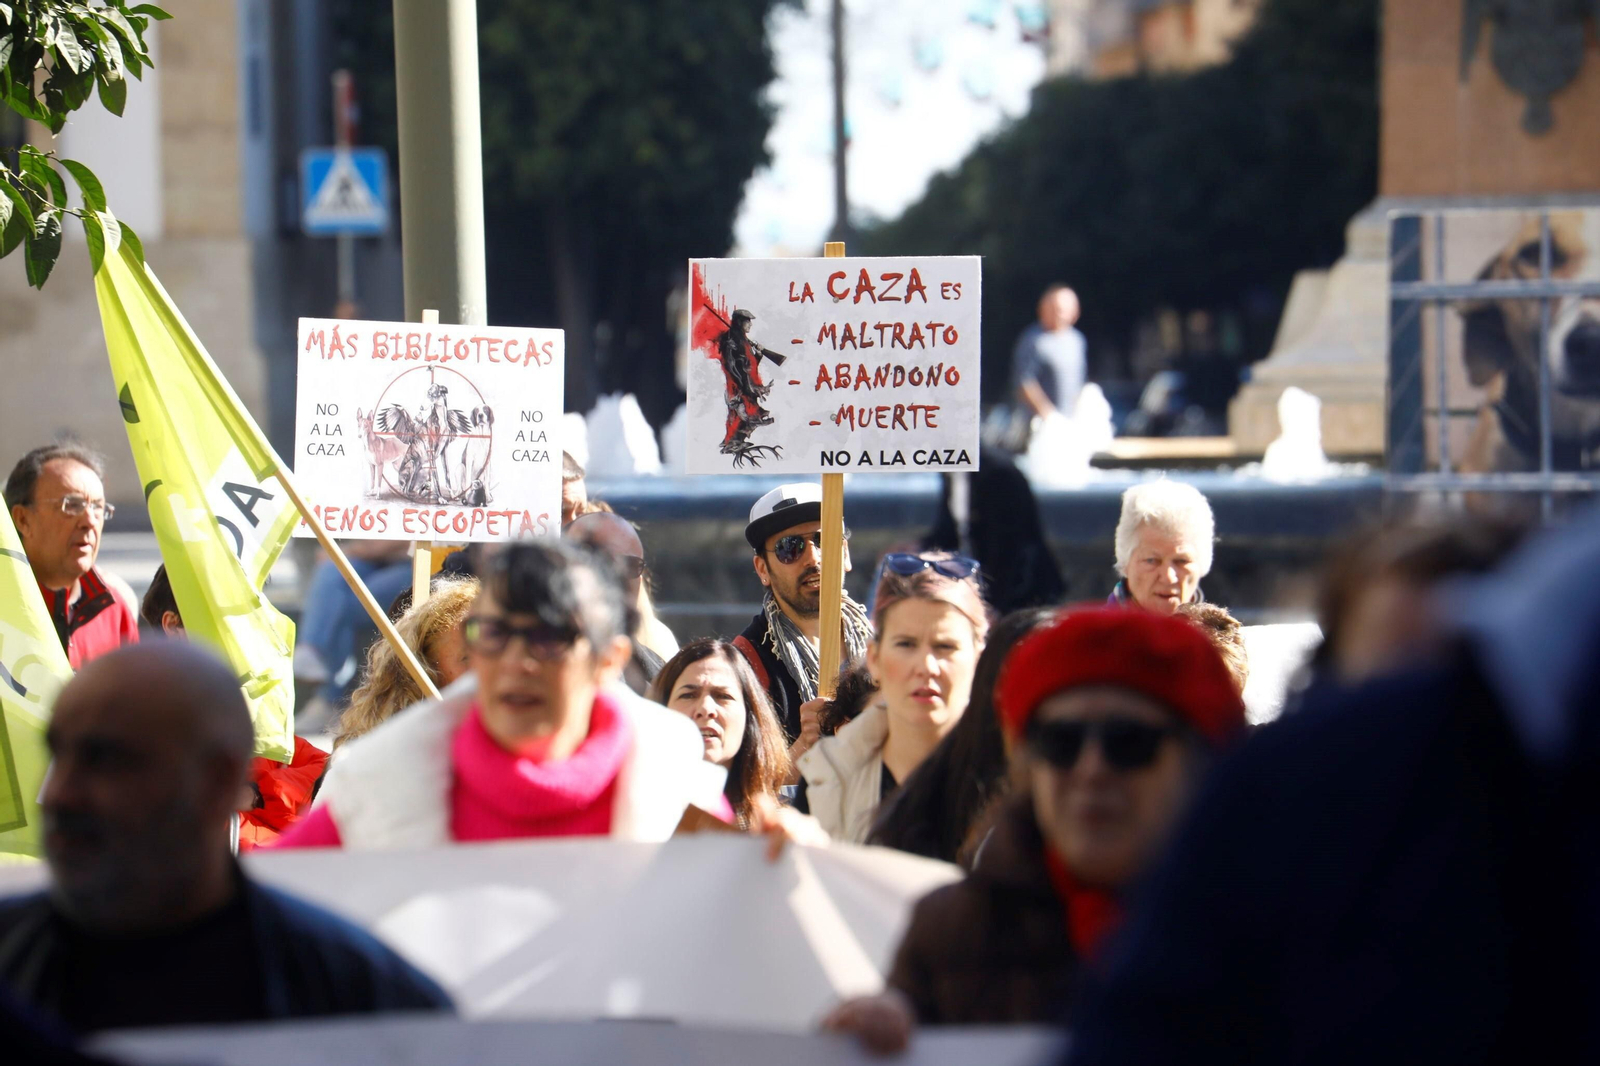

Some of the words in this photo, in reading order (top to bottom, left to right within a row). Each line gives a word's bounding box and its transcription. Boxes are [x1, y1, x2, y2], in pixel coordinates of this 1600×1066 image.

[788, 281, 814, 303] LA
[826, 268, 927, 304] CAZA
[940, 282, 962, 300] ES
[817, 321, 958, 350] MALTRATO
[305, 325, 358, 360] MÁS
[371, 331, 554, 367] BIBLIOTECAS
[814, 363, 960, 391] ABANDONO
[316, 403, 339, 416] NO
[520, 410, 543, 423] NO
[835, 403, 941, 431] MUERTE
[310, 424, 321, 436] A
[325, 424, 343, 436] LA
[515, 430, 526, 442] A
[530, 430, 548, 443] LA
[307, 443, 345, 456] CAZA
[512, 449, 550, 463] CAZA
[821, 450, 851, 466] NO
[857, 450, 873, 466] A
[880, 450, 906, 465] LA
[913, 449, 971, 465] CAZA
[402, 507, 549, 539] ESCOPETAS
